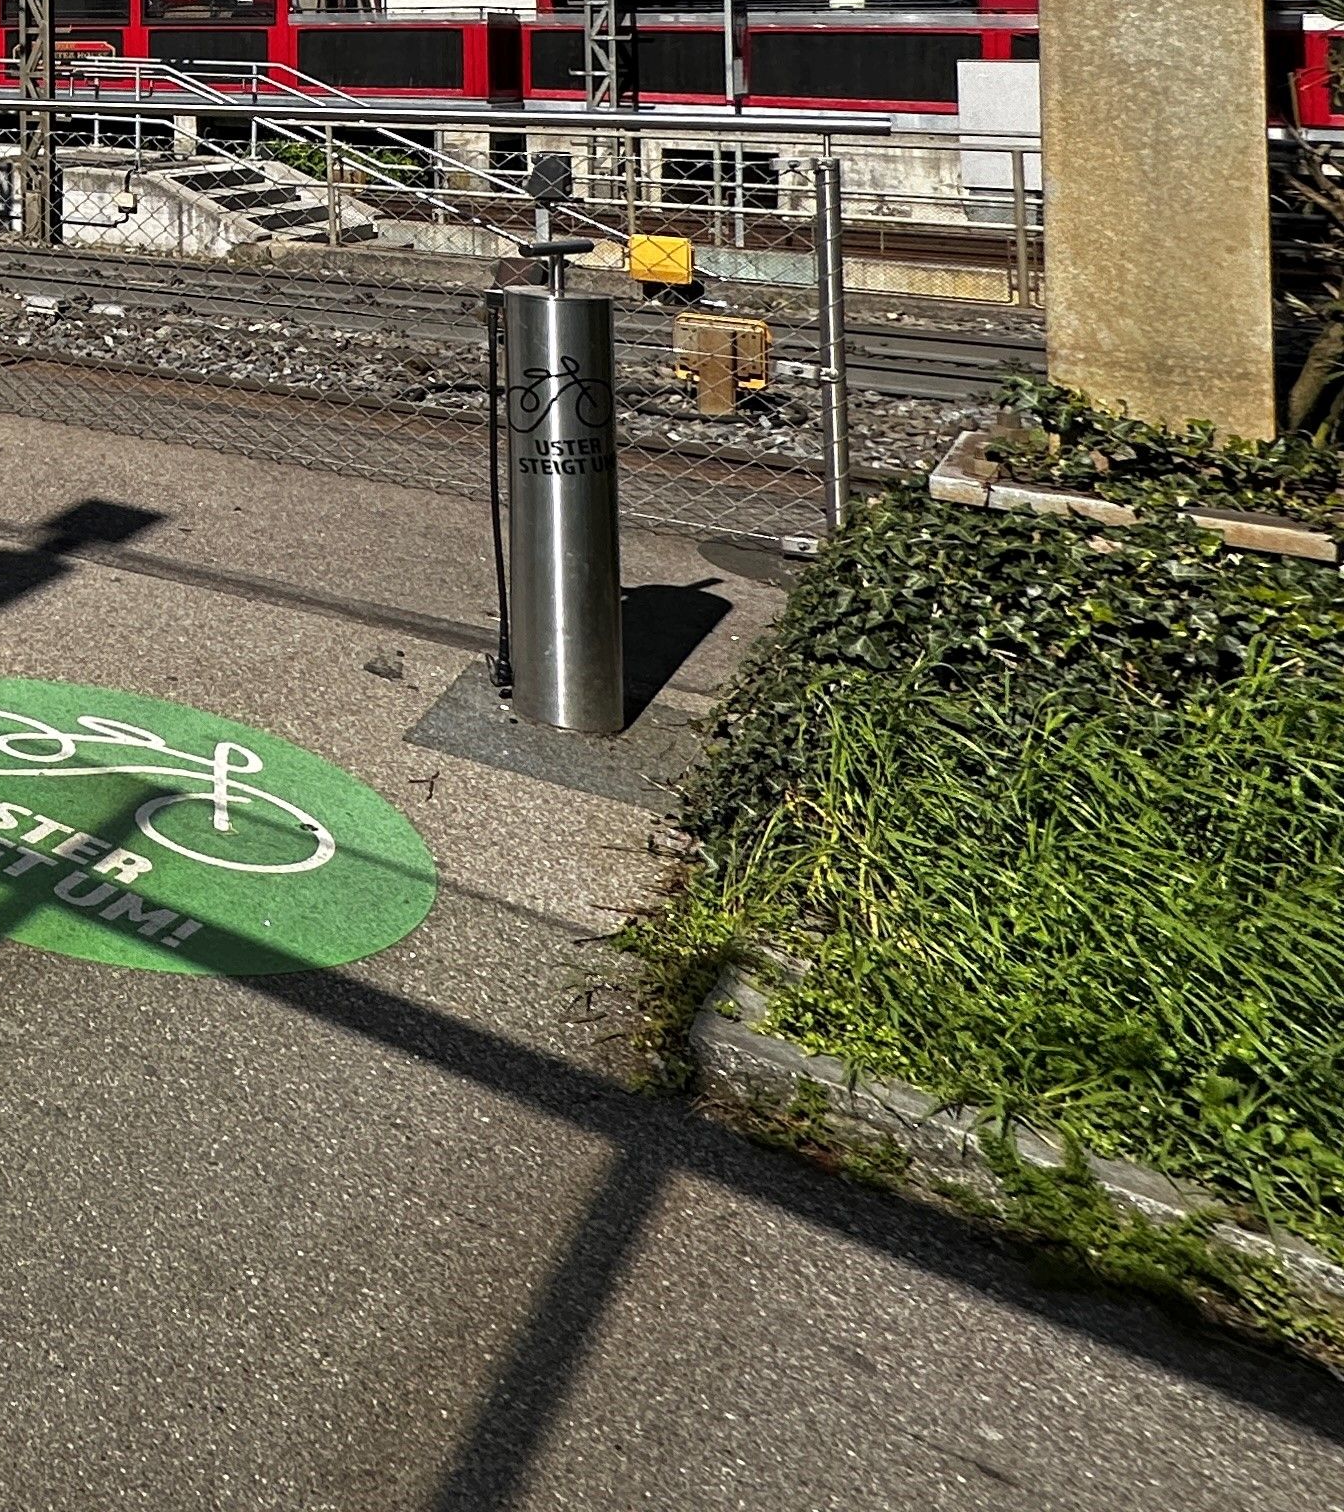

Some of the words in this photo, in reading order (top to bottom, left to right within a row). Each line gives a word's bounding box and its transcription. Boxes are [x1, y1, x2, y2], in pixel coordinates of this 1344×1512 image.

[534, 438, 602, 456] USTER
[518, 457, 588, 475] STEIGT
[52, 870, 204, 949] UM!
